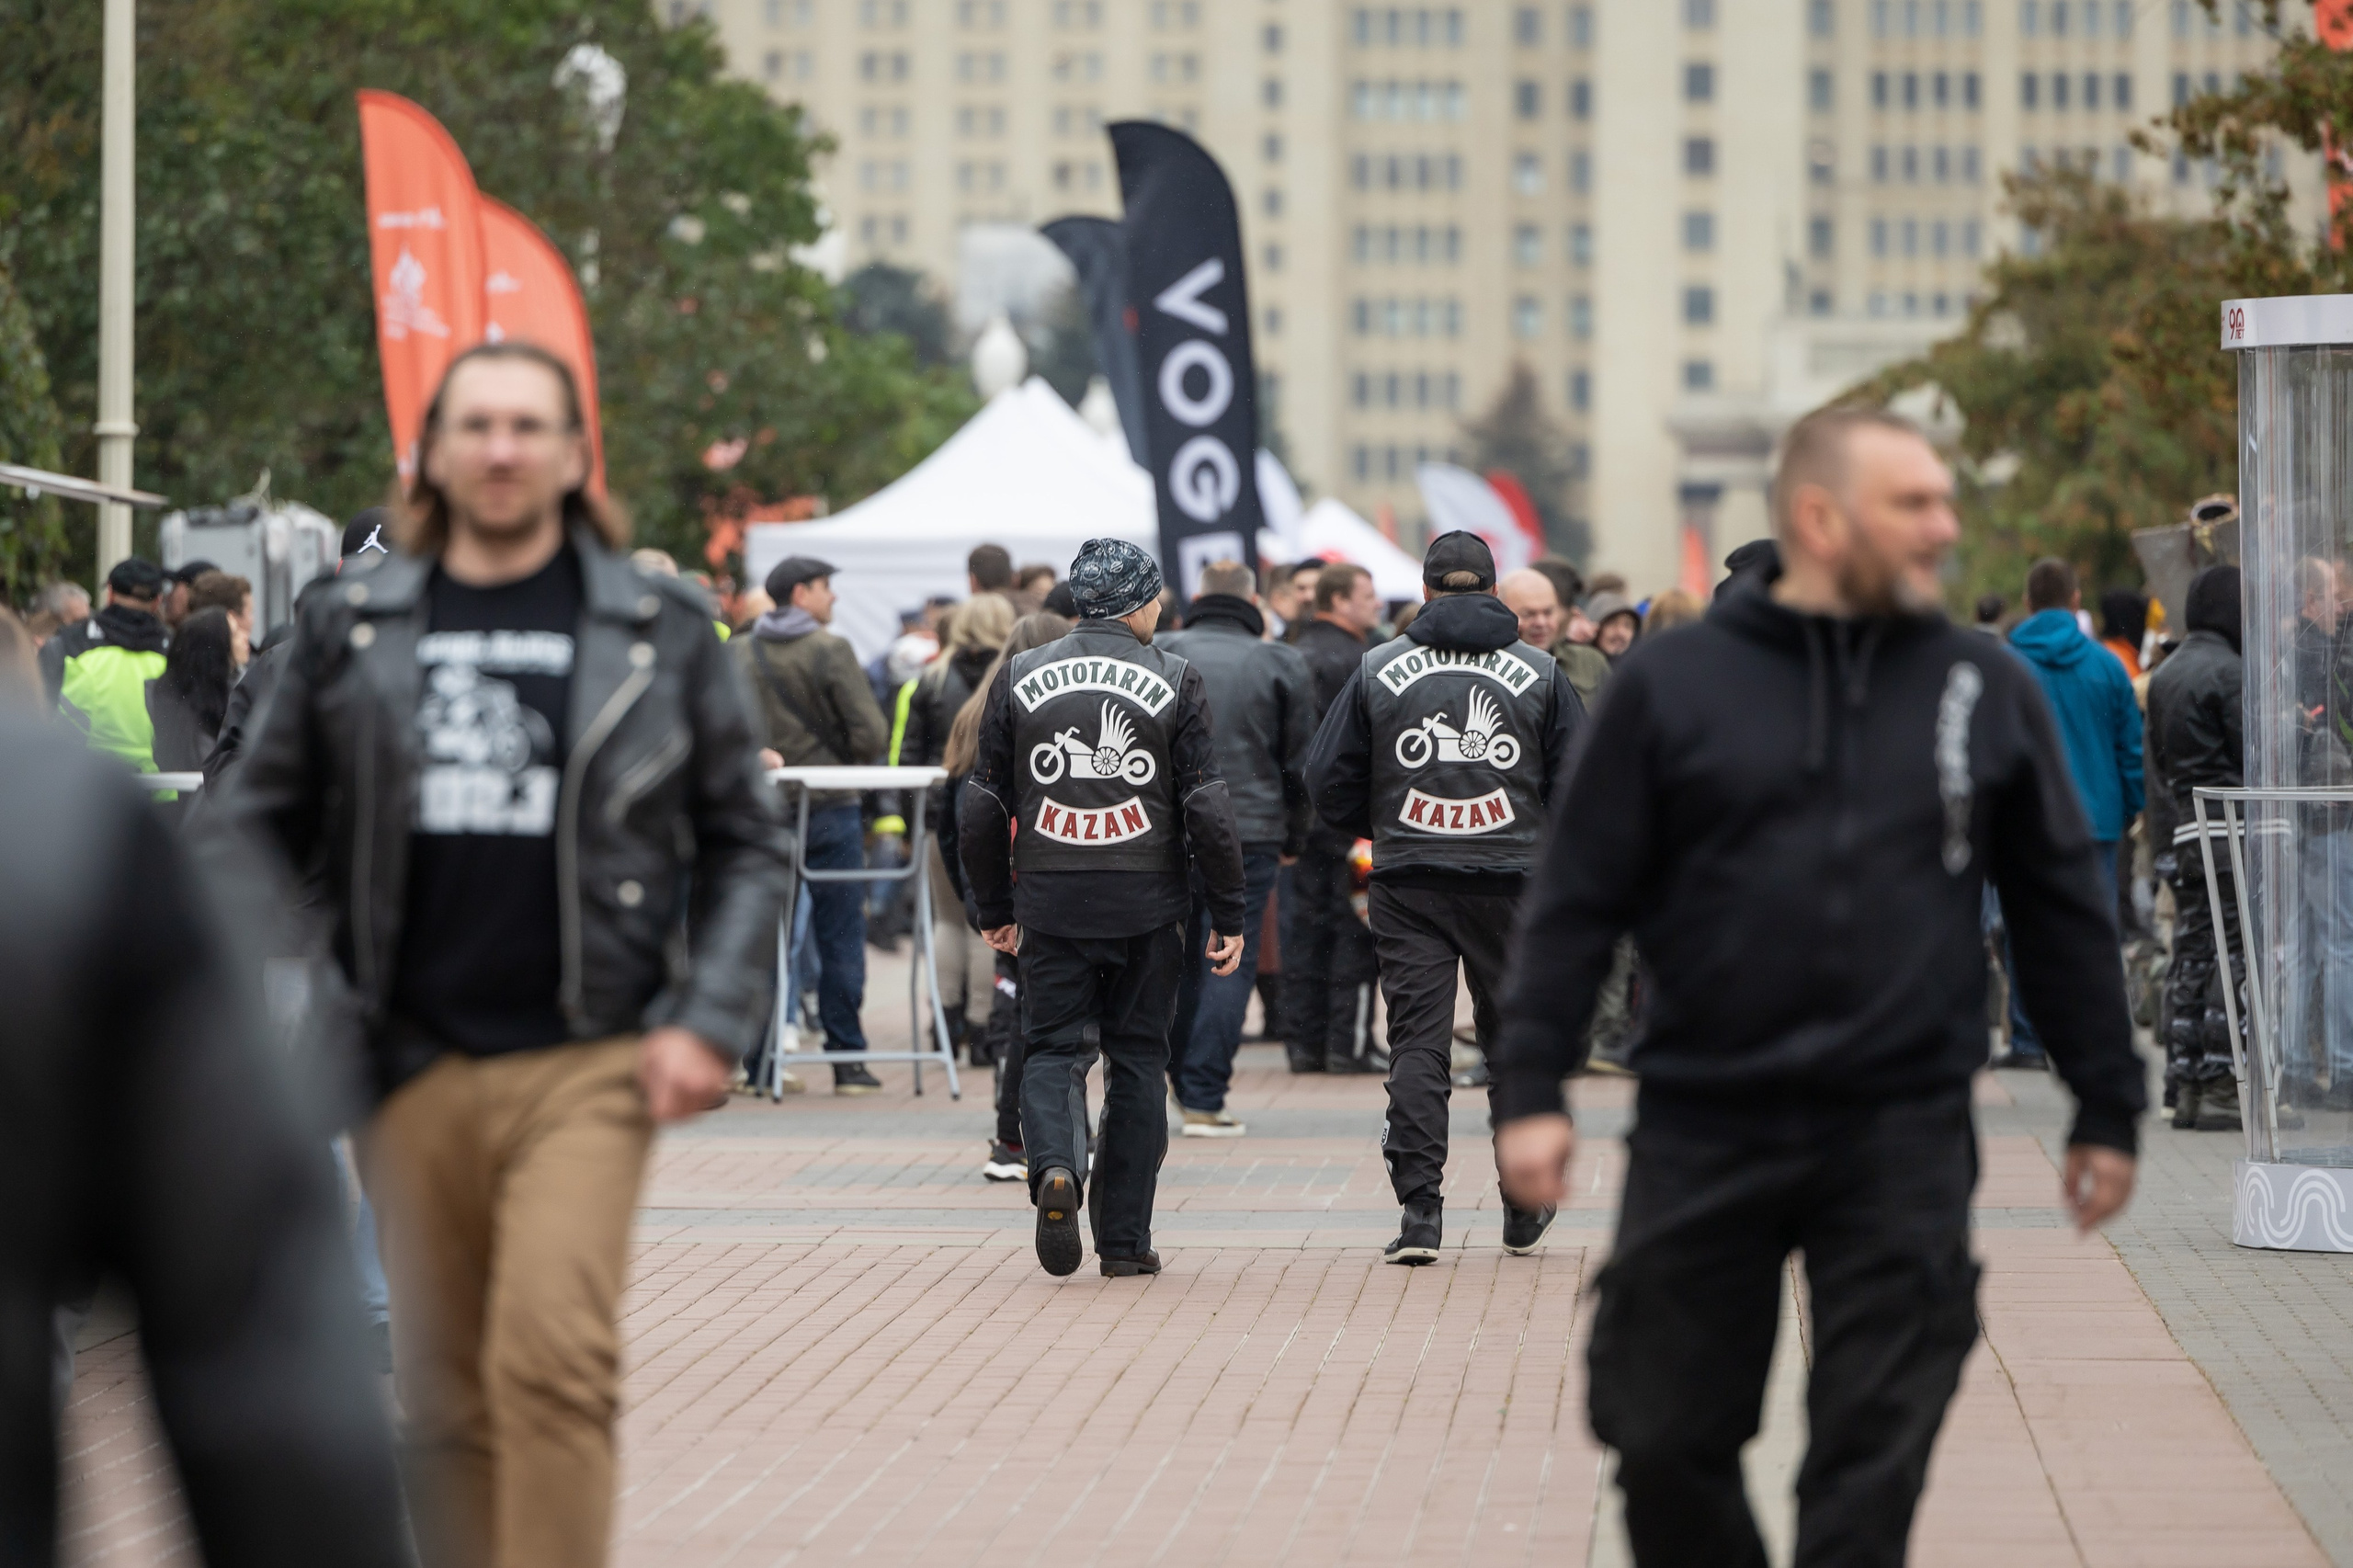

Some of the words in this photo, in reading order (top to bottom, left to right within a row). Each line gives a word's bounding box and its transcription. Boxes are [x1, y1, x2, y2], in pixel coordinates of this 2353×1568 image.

[1021, 661, 1168, 709] MOTOTARIN
[1040, 803, 1145, 840] KAZAN
[1407, 797, 1506, 828] KAZAN
